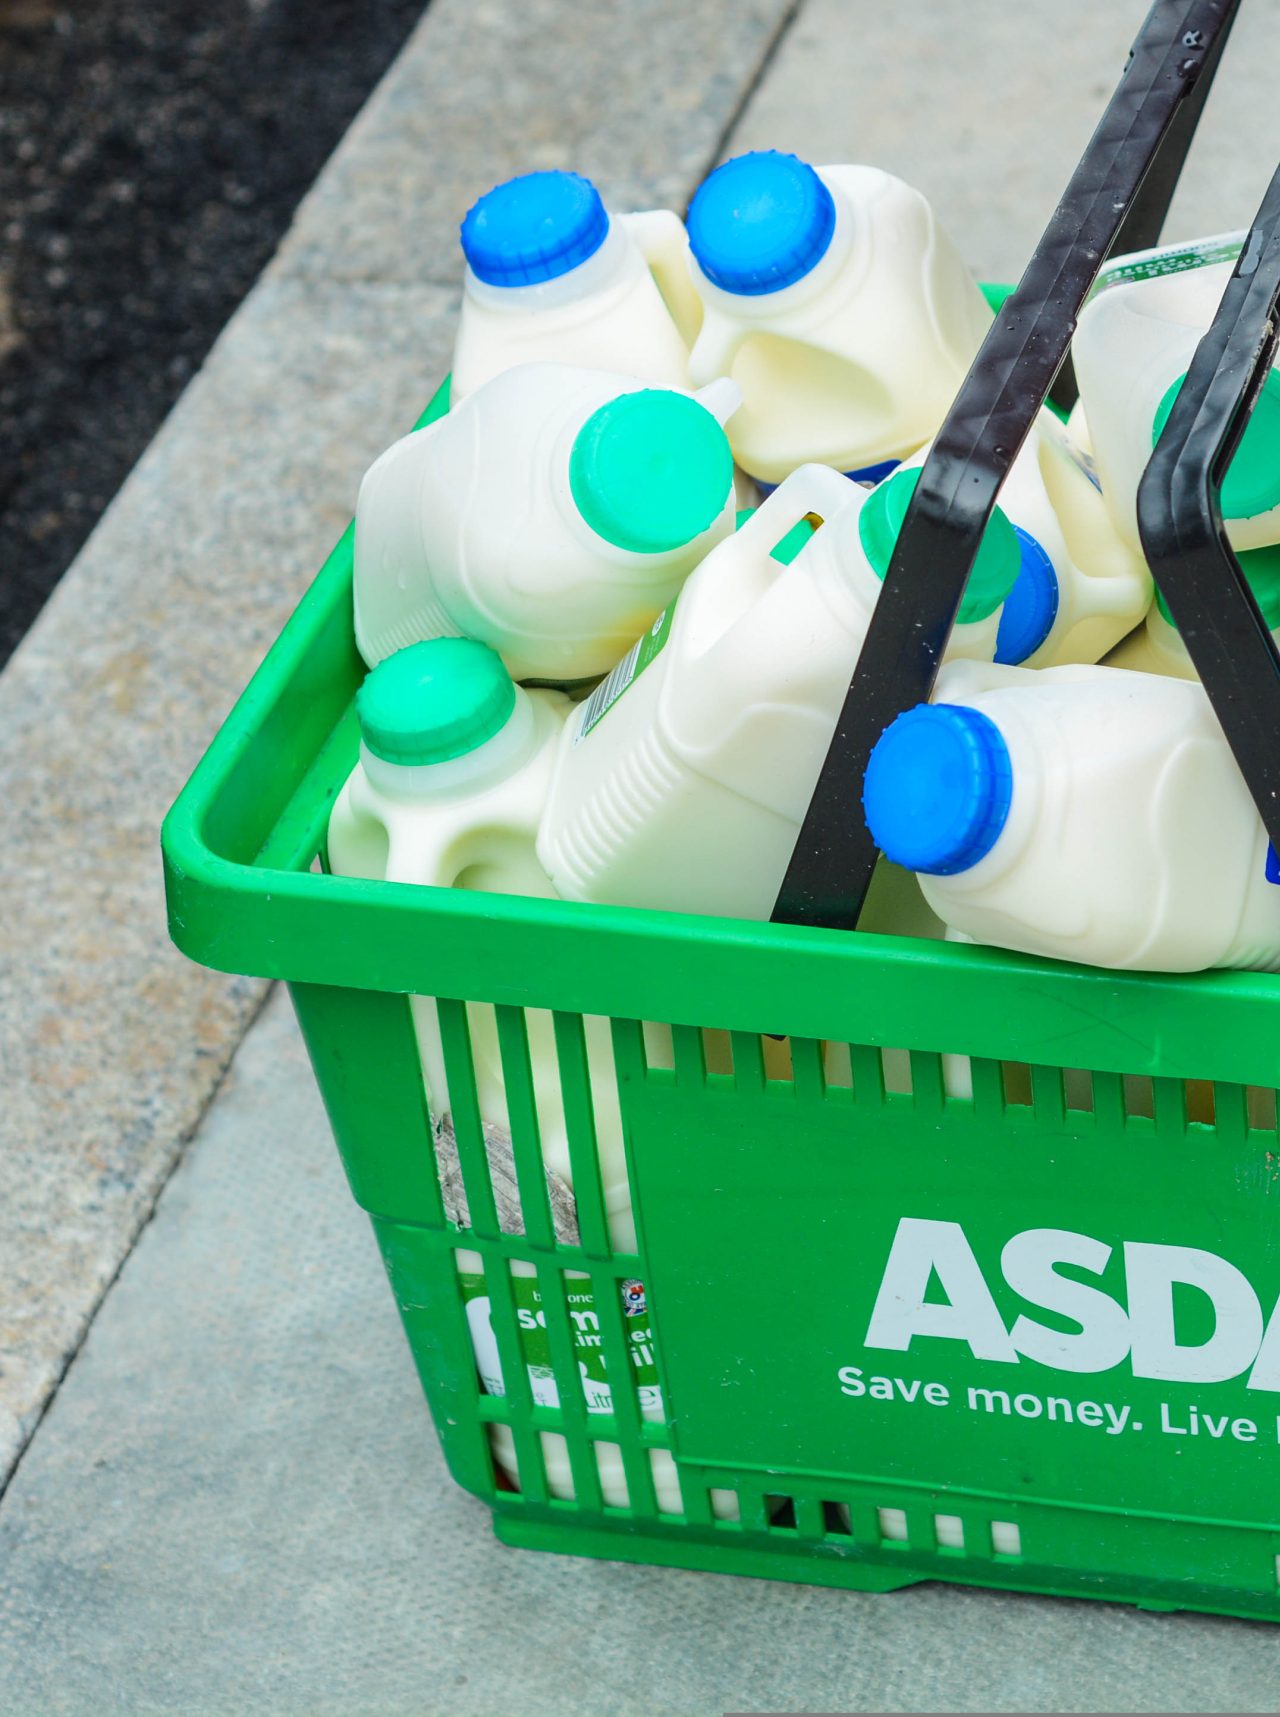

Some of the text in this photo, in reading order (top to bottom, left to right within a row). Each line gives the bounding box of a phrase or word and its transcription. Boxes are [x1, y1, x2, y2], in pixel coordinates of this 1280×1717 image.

[837, 1366, 950, 1406] Save
[967, 1385, 1143, 1436] money.
[1160, 1402, 1258, 1442] Live
